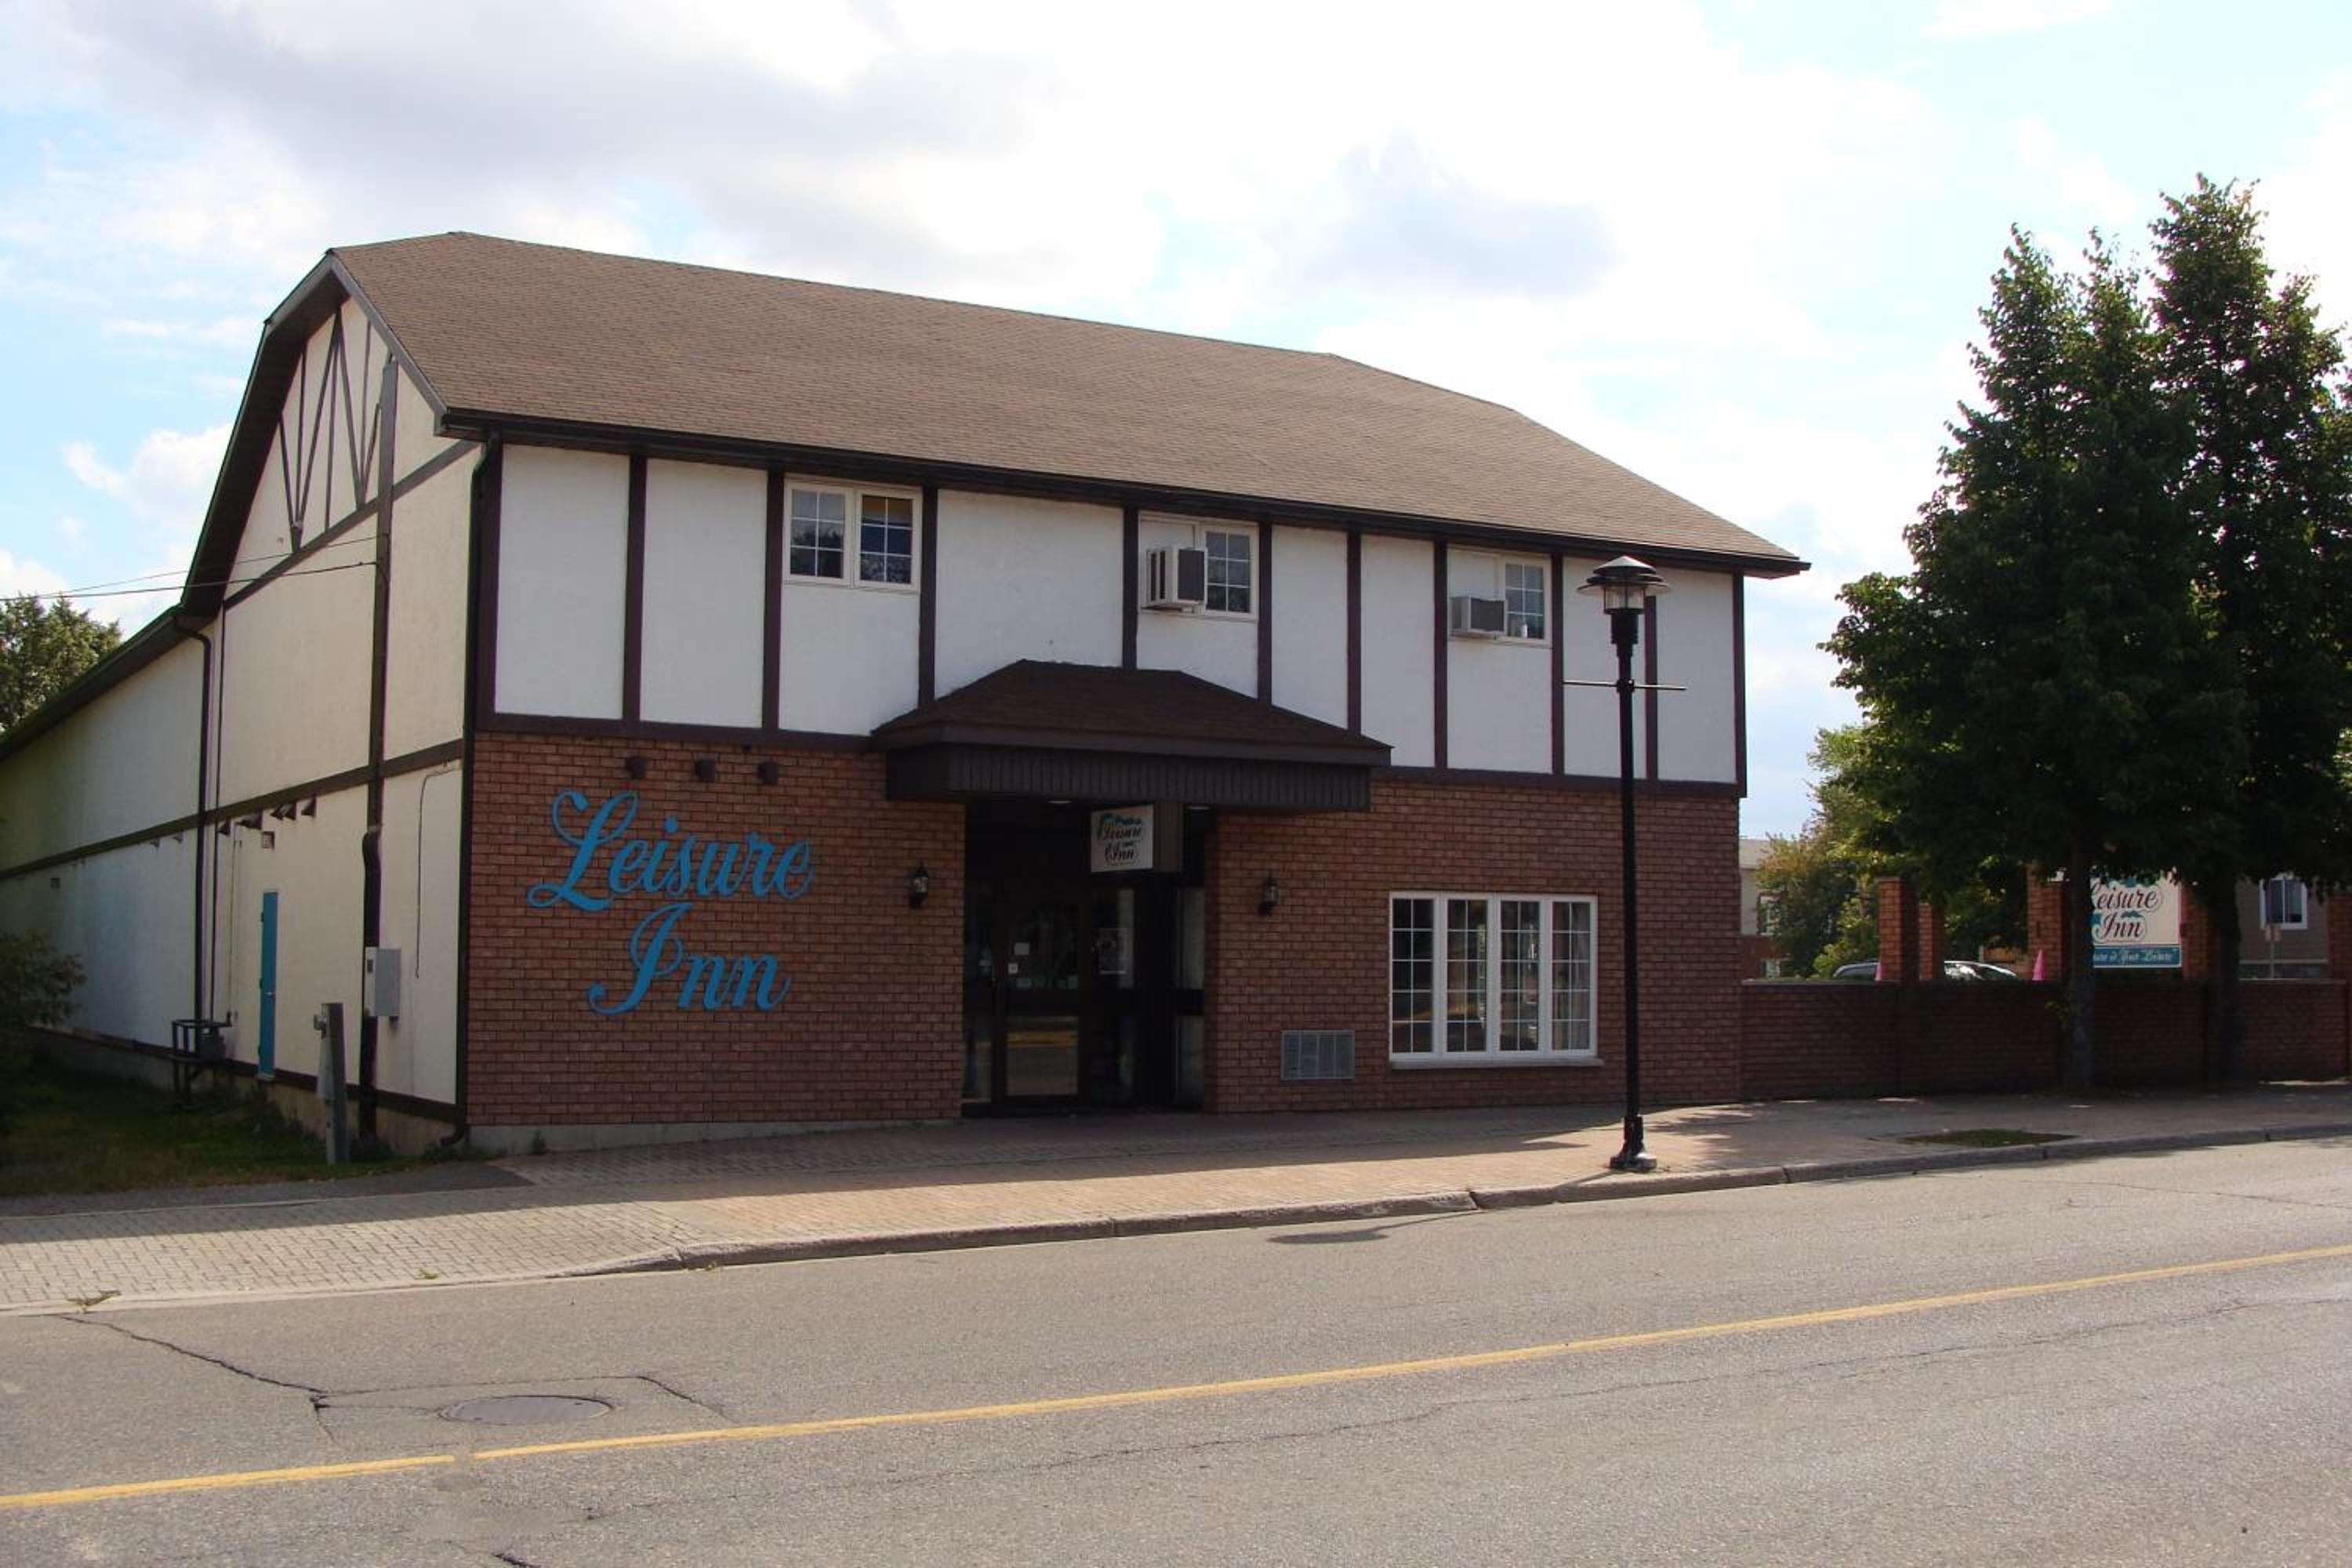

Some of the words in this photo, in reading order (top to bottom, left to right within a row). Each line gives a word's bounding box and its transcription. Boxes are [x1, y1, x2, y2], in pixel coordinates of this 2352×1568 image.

[527, 790, 815, 911] Leisure
[2092, 881, 2158, 909] eisure
[2096, 912, 2144, 938] Inn
[589, 902, 792, 1015] Inn
